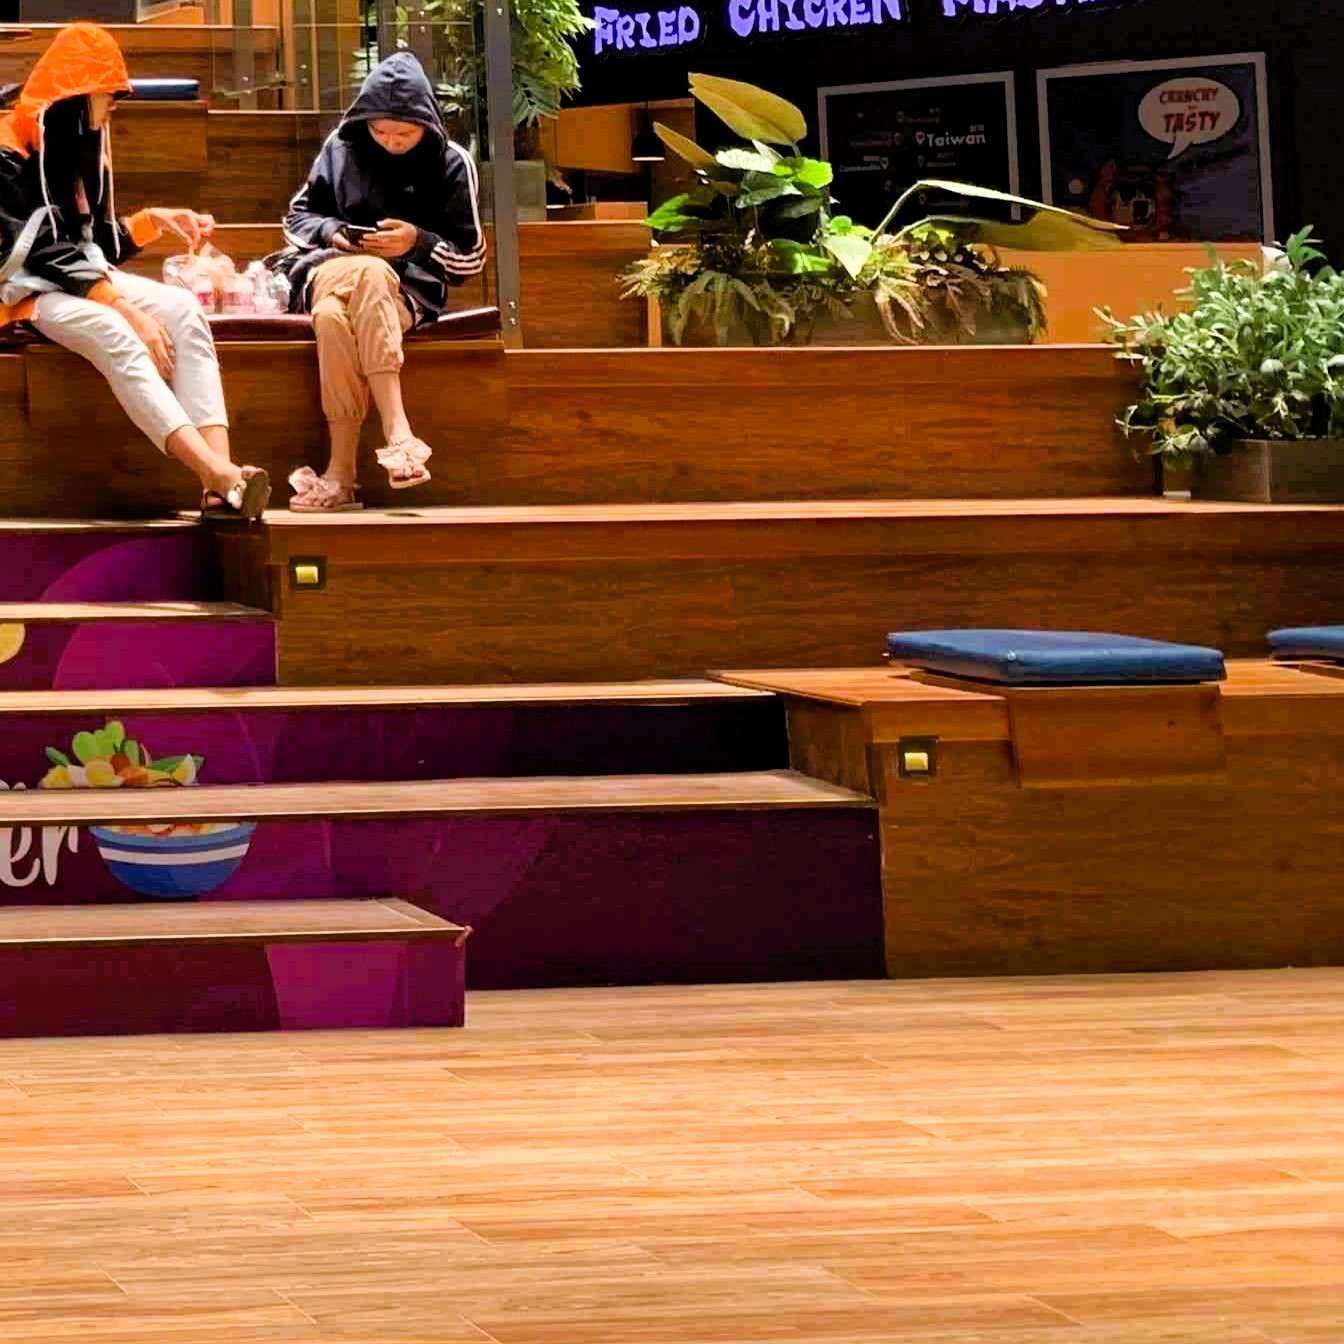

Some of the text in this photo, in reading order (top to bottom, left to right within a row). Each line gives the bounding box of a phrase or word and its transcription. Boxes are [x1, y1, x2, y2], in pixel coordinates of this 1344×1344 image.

[594, 5, 700, 54] FRIED
[1164, 111, 1221, 133] TASTY
[926, 131, 986, 147] Taiwan
